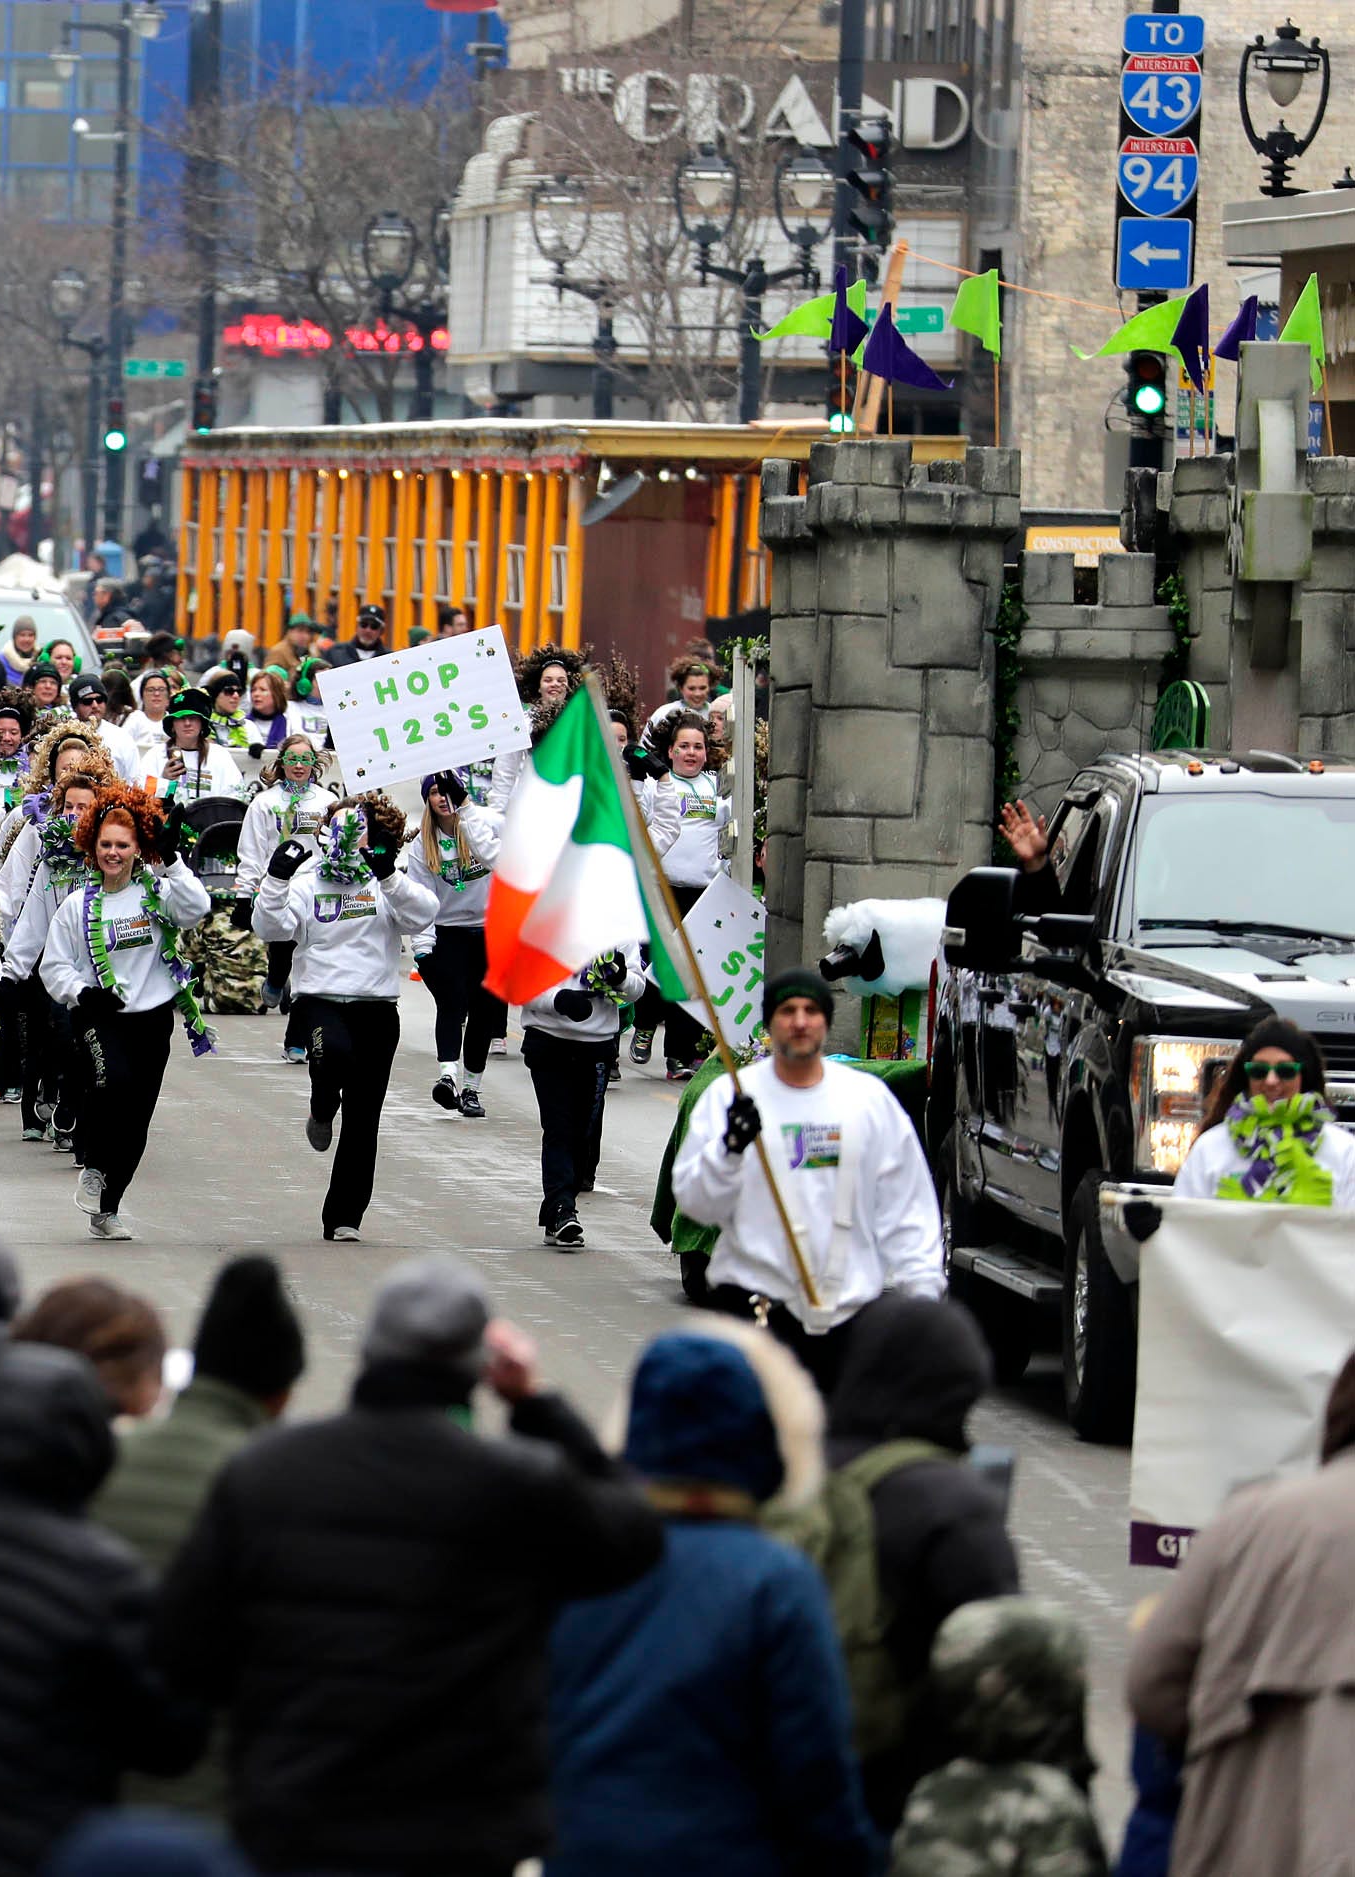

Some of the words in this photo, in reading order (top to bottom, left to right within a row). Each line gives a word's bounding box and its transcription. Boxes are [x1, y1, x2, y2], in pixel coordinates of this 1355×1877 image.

[1144, 22, 1185, 46] TO
[1134, 60, 1191, 71] INTERSTATE
[557, 66, 616, 95] THE
[613, 68, 970, 150] GRAND
[1129, 76, 1192, 120] 43
[1130, 140, 1187, 153] INTERSTATE
[1123, 157, 1186, 201] 94
[1032, 536, 1124, 551] CONSTRUCTION
[373, 662, 460, 705] HOP
